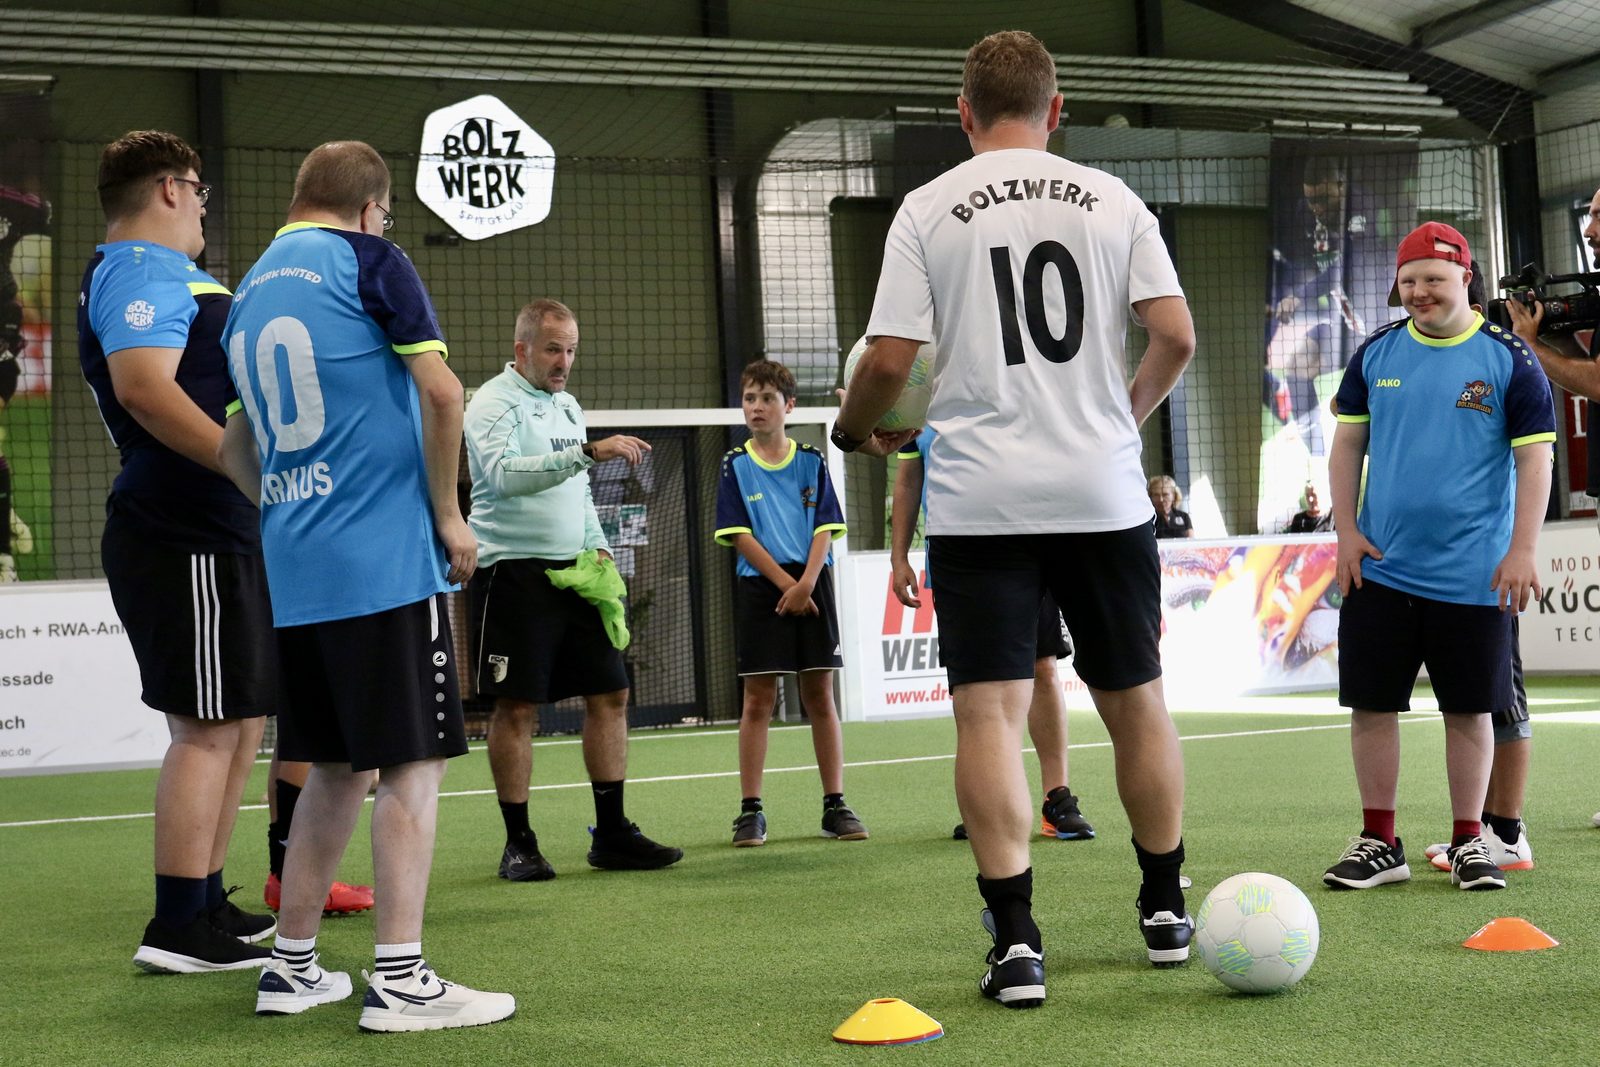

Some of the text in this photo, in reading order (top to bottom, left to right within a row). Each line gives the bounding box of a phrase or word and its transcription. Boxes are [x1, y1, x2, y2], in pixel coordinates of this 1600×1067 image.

[443, 118, 524, 160] BOLZ
[437, 162, 525, 208] WERK
[950, 178, 1100, 224] BOLZWERK
[280, 267, 322, 284] UNITED
[989, 239, 1085, 366] 10
[1376, 379, 1401, 388] JAKO
[1551, 555, 1600, 572] MOD
[1555, 627, 1600, 642] TEC
